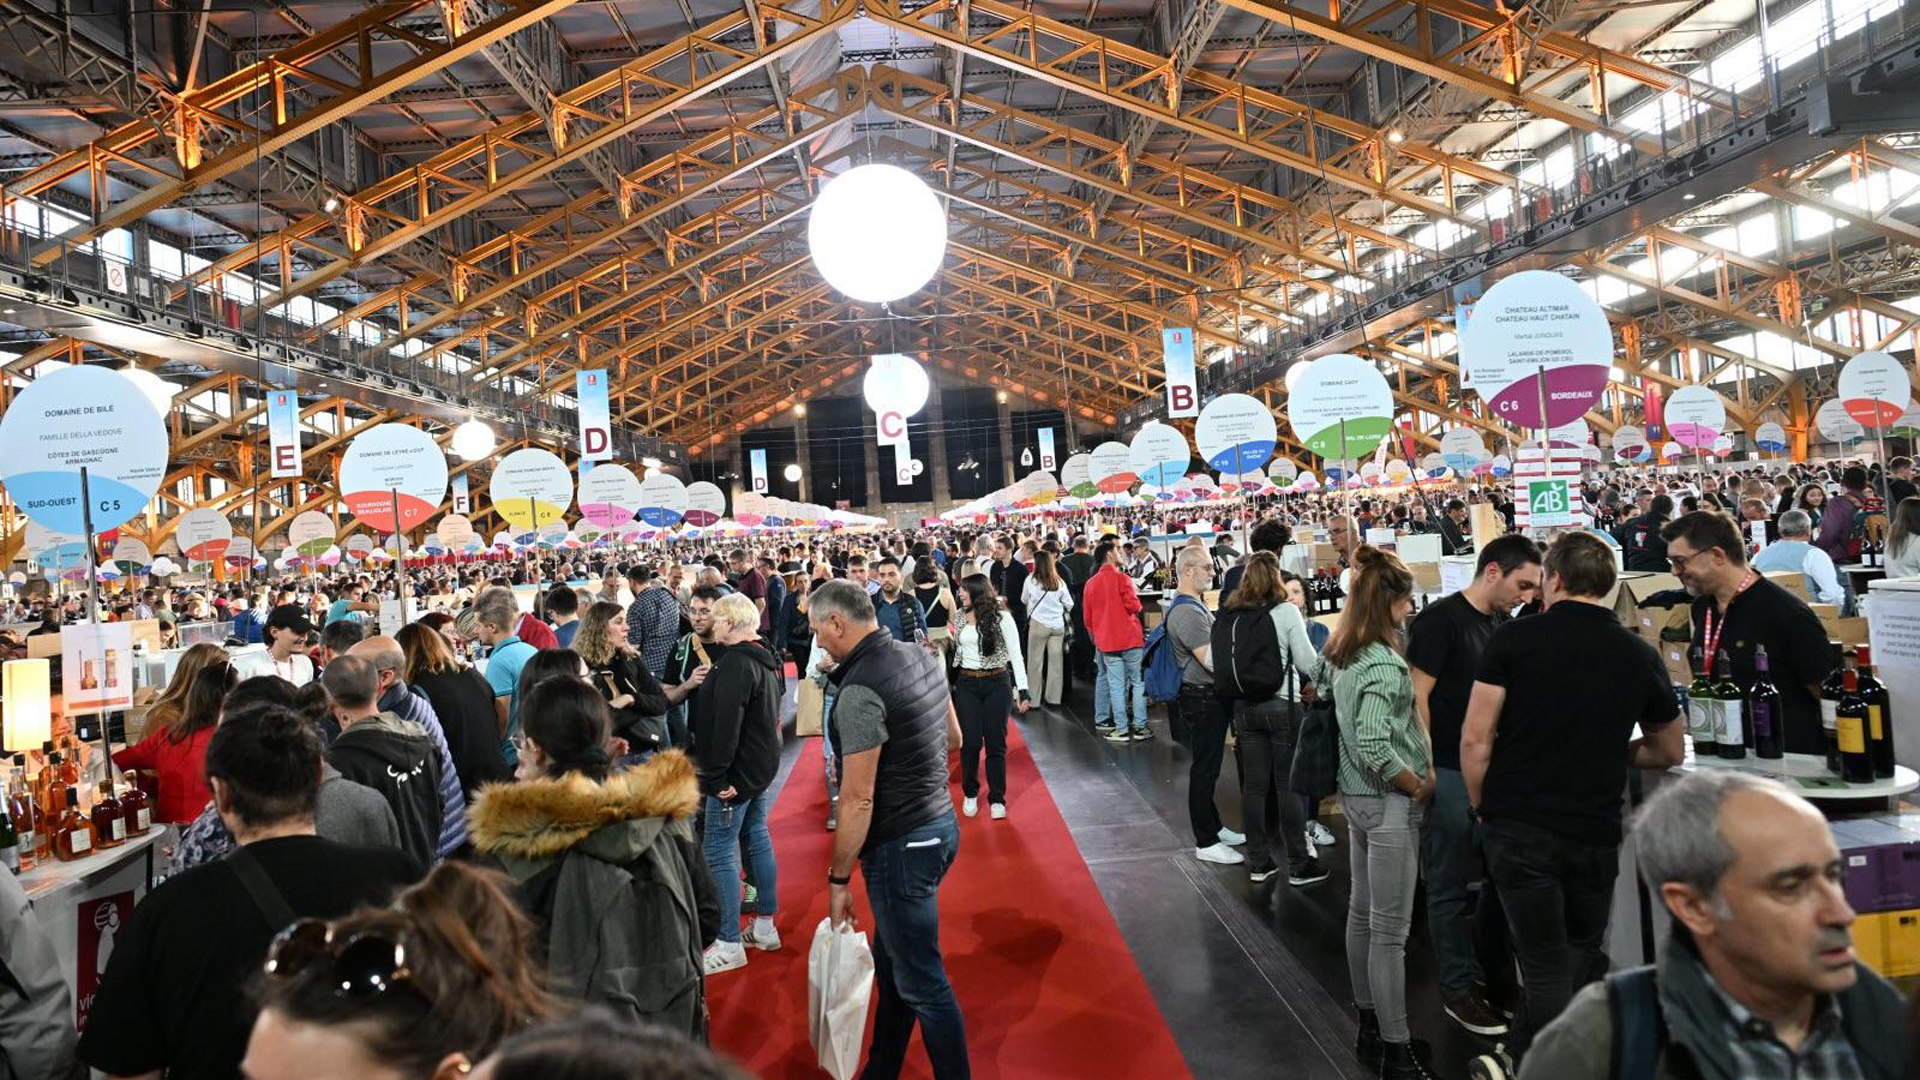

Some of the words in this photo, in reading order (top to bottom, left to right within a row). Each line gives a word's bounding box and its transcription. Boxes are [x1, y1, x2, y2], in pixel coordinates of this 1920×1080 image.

[1171, 384, 1194, 411] B
[1551, 390, 1593, 400] BORDEAUX
[44, 407, 82, 418] DOMAINE
[83, 405, 94, 414] DE
[1500, 401, 1509, 412] C
[1511, 400, 1519, 411] 6
[880, 411, 903, 438] C
[39, 433, 69, 442] FAMILLE
[585, 428, 608, 454] D
[81, 447, 118, 456] GASCOGNE
[276, 445, 297, 470] E
[65, 456, 103, 465] ARMAGNAC
[1042, 455, 1054, 468] B
[899, 468, 911, 481] C
[754, 477, 766, 491] D
[28, 497, 77, 509] SUD-OUEST
[100, 501, 110, 512] C
[113, 499, 121, 510] 5
[456, 496, 466, 510] F
[1533, 490, 1563, 513] AB
[404, 509, 411, 517] C
[412, 508, 418, 516] 7
